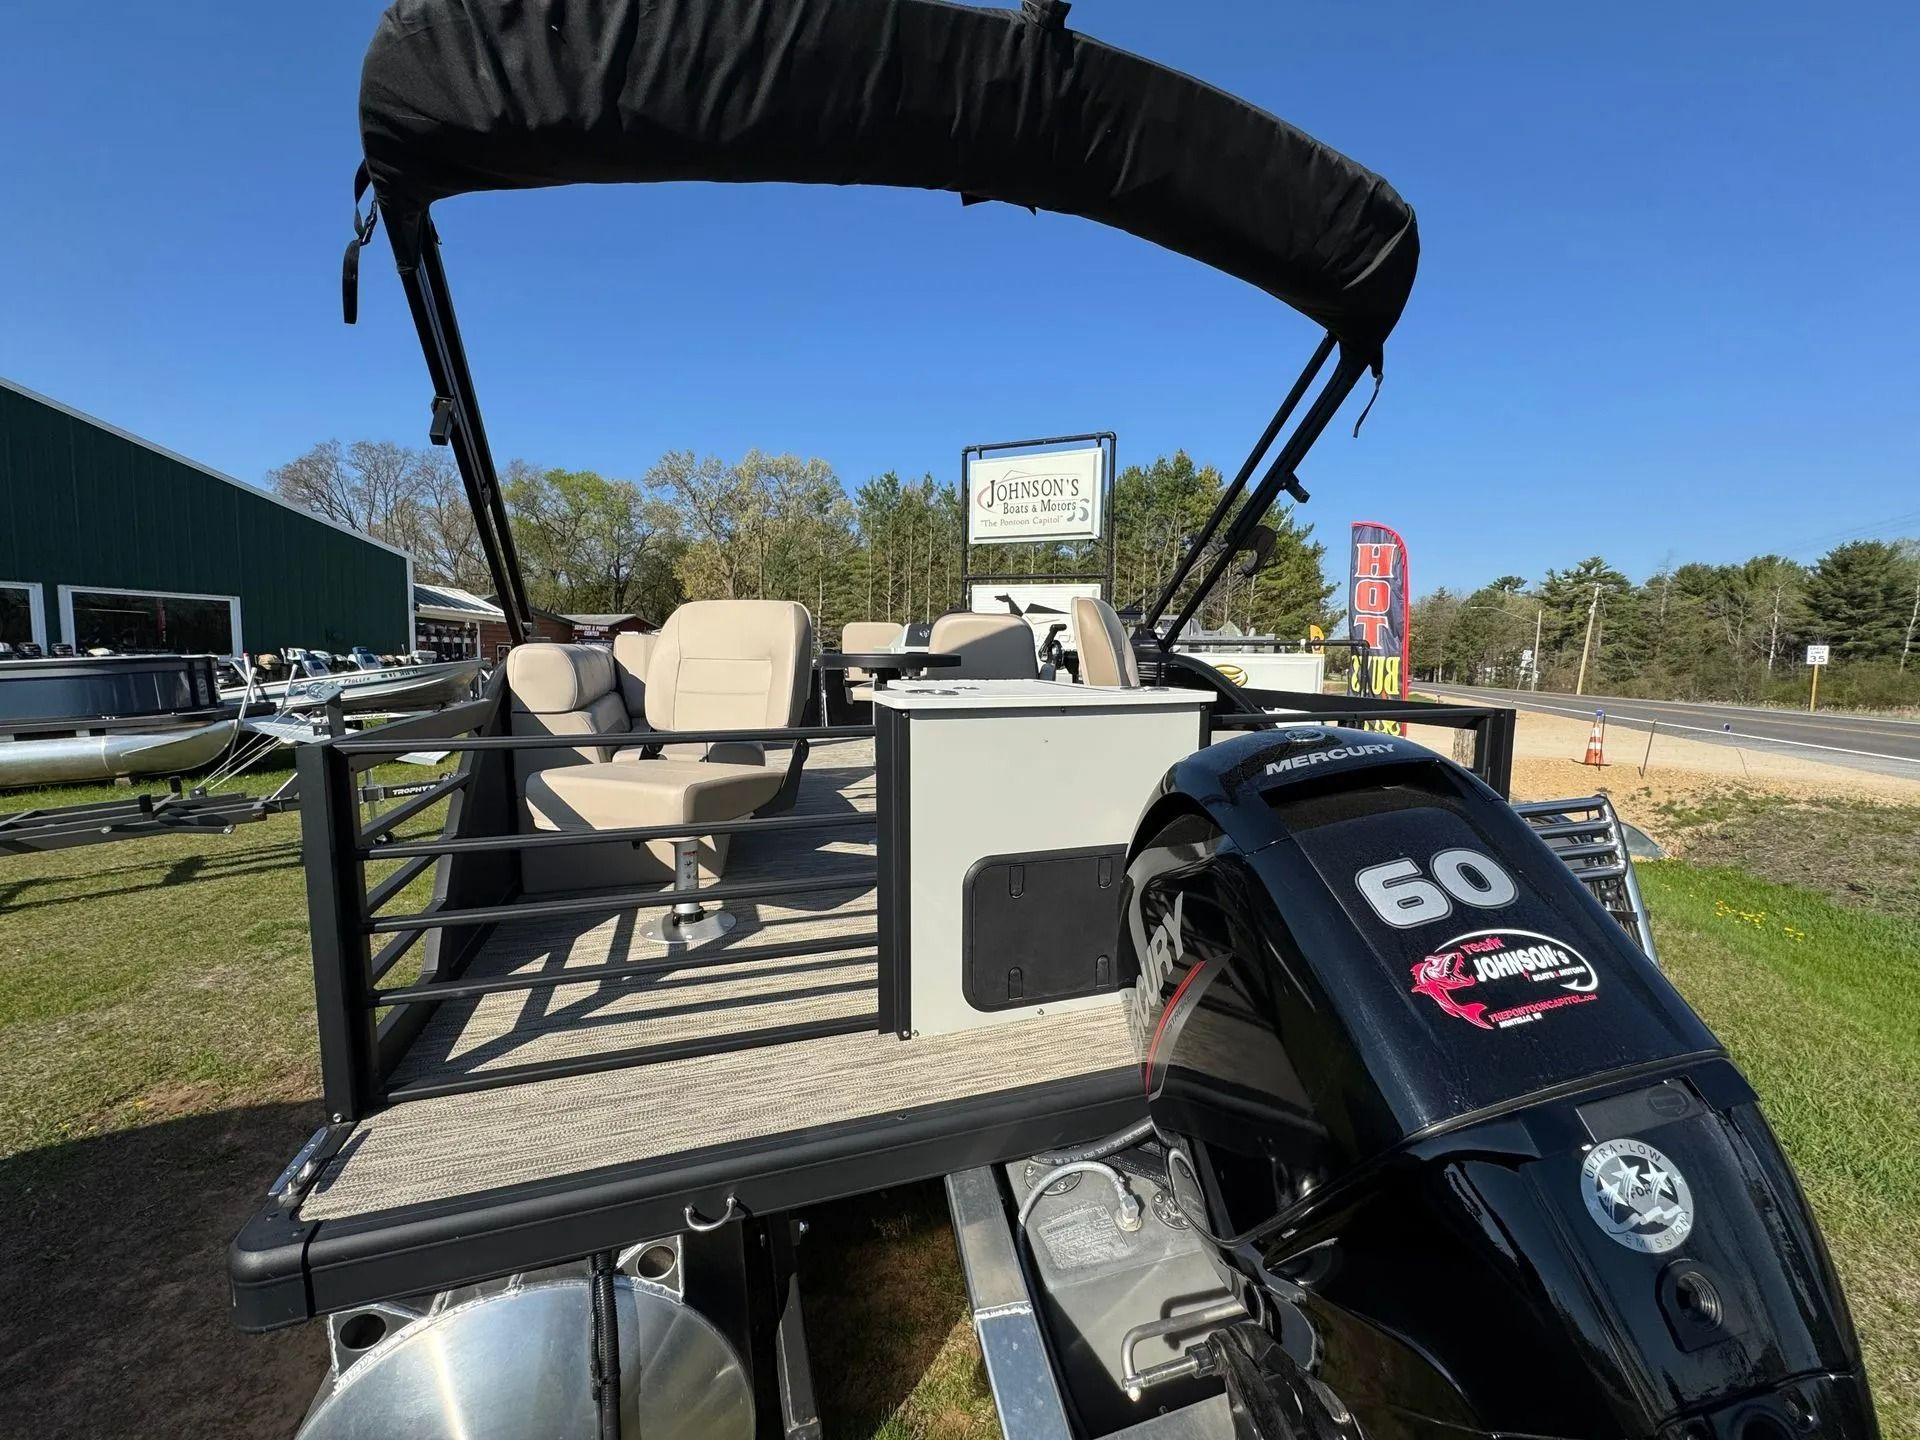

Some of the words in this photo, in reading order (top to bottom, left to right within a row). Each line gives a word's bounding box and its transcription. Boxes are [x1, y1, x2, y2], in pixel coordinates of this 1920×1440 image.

[987, 479, 1079, 508] JOHNSON'S
[1003, 502, 1029, 514] Boats
[1040, 499, 1077, 512] Motors
[1000, 517, 1030, 526] Pontoon
[1354, 543, 1397, 650] HOT
[1809, 655, 1825, 663] 35
[1265, 743, 1395, 776] MERCURY
[392, 785, 428, 796] TROPHY
[1355, 847, 1519, 929] 60
[1559, 965, 1587, 976] MOTORS
[1584, 1142, 1618, 1179] ULTRA
[1628, 1142, 1661, 1162] LOW
[1624, 1215, 1690, 1251] EMISSION
